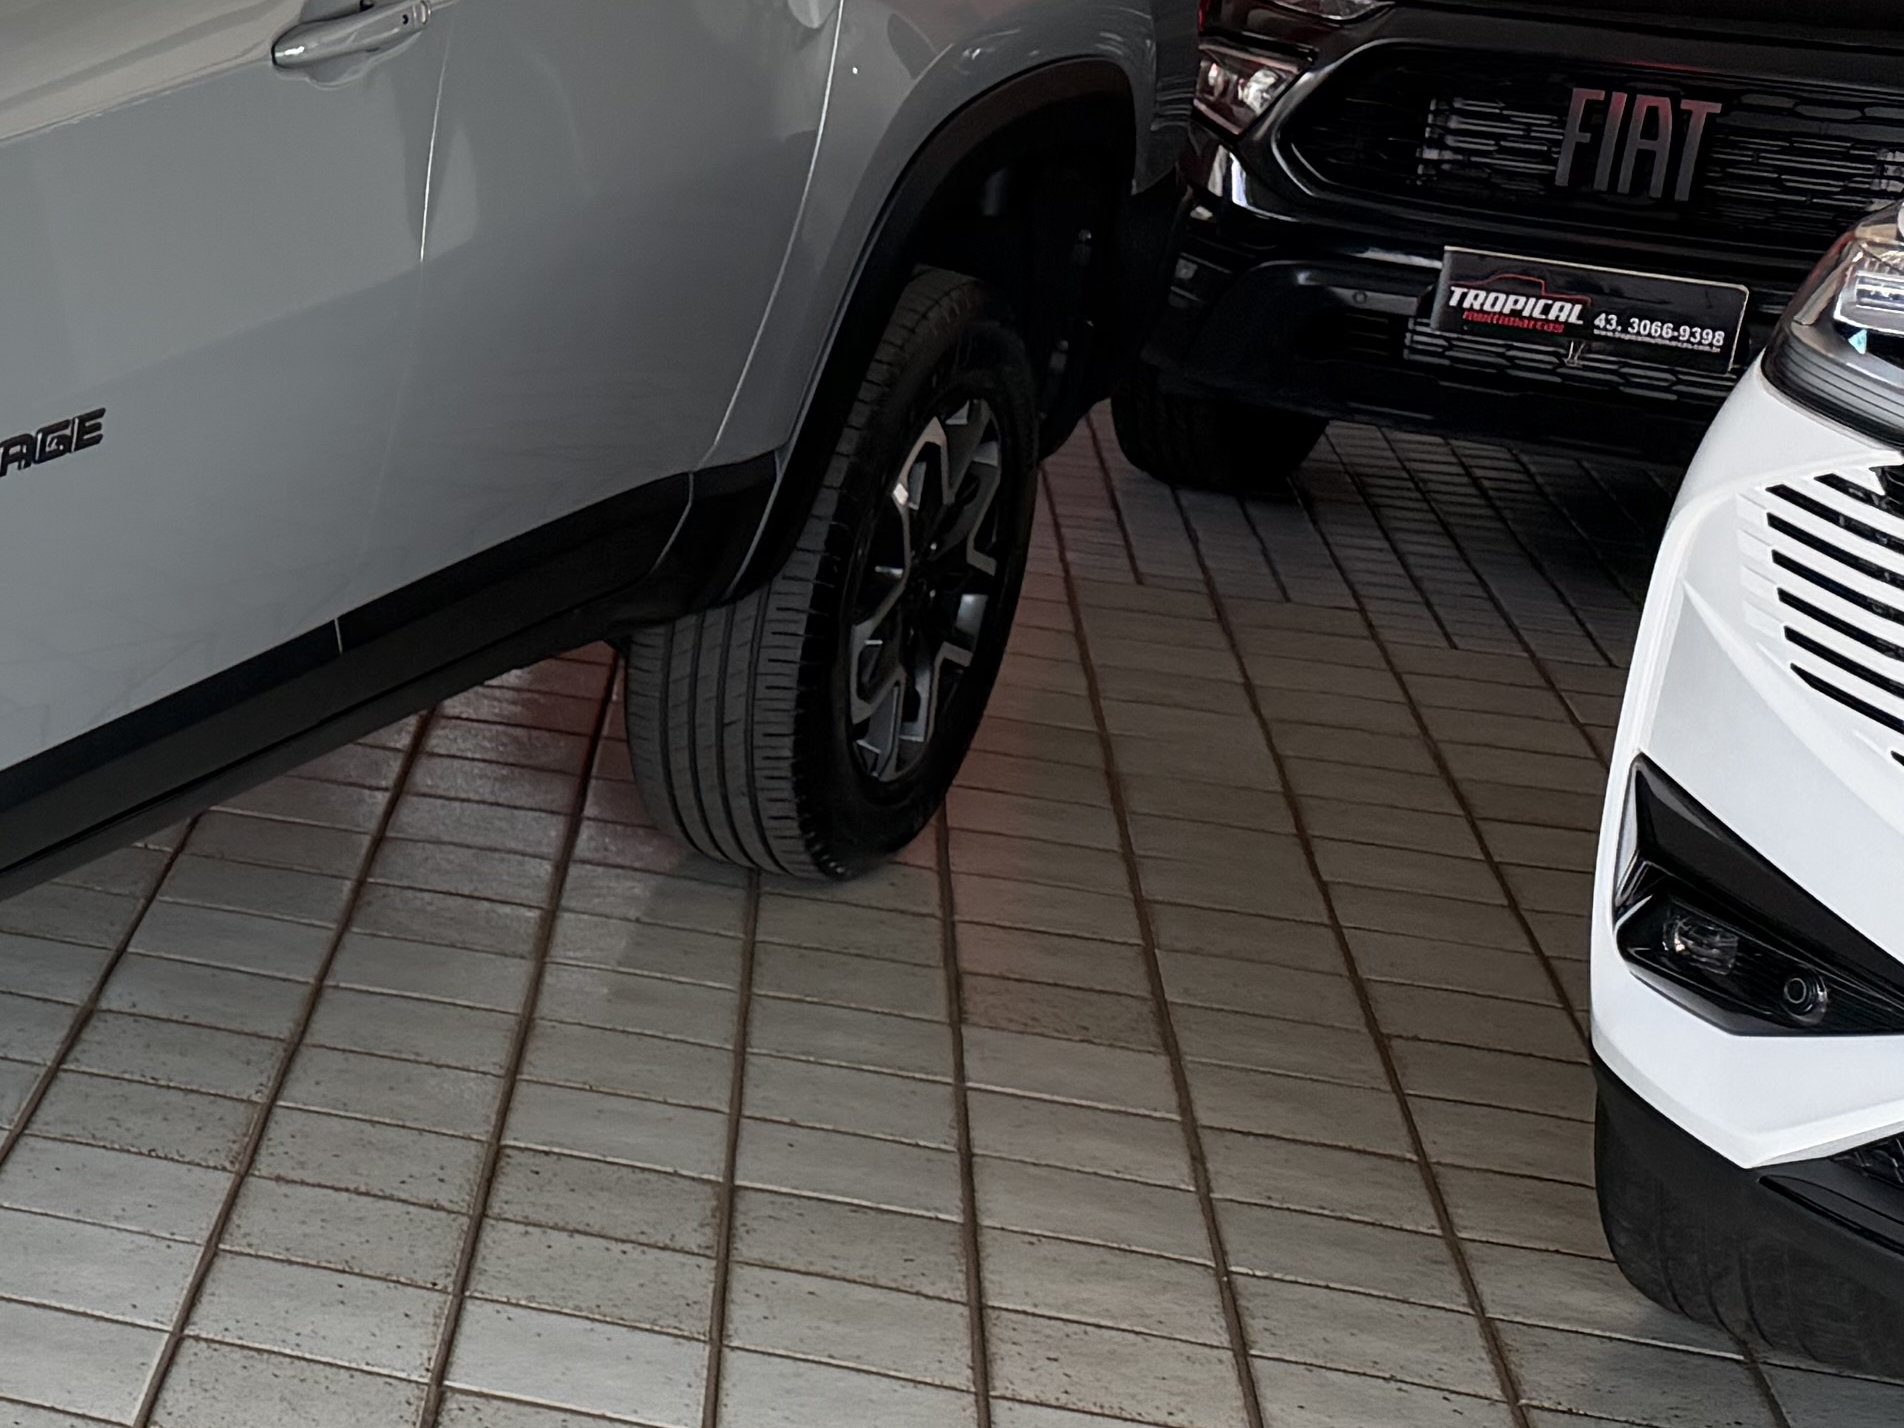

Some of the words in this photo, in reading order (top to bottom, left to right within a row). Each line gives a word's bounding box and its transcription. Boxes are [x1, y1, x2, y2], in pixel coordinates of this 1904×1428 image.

[1554, 88, 1722, 201] FIAT
[1448, 285, 1584, 325] TROPICAL
[1594, 312, 1622, 332] 43.
[1627, 318, 1725, 347] 3066-9398
